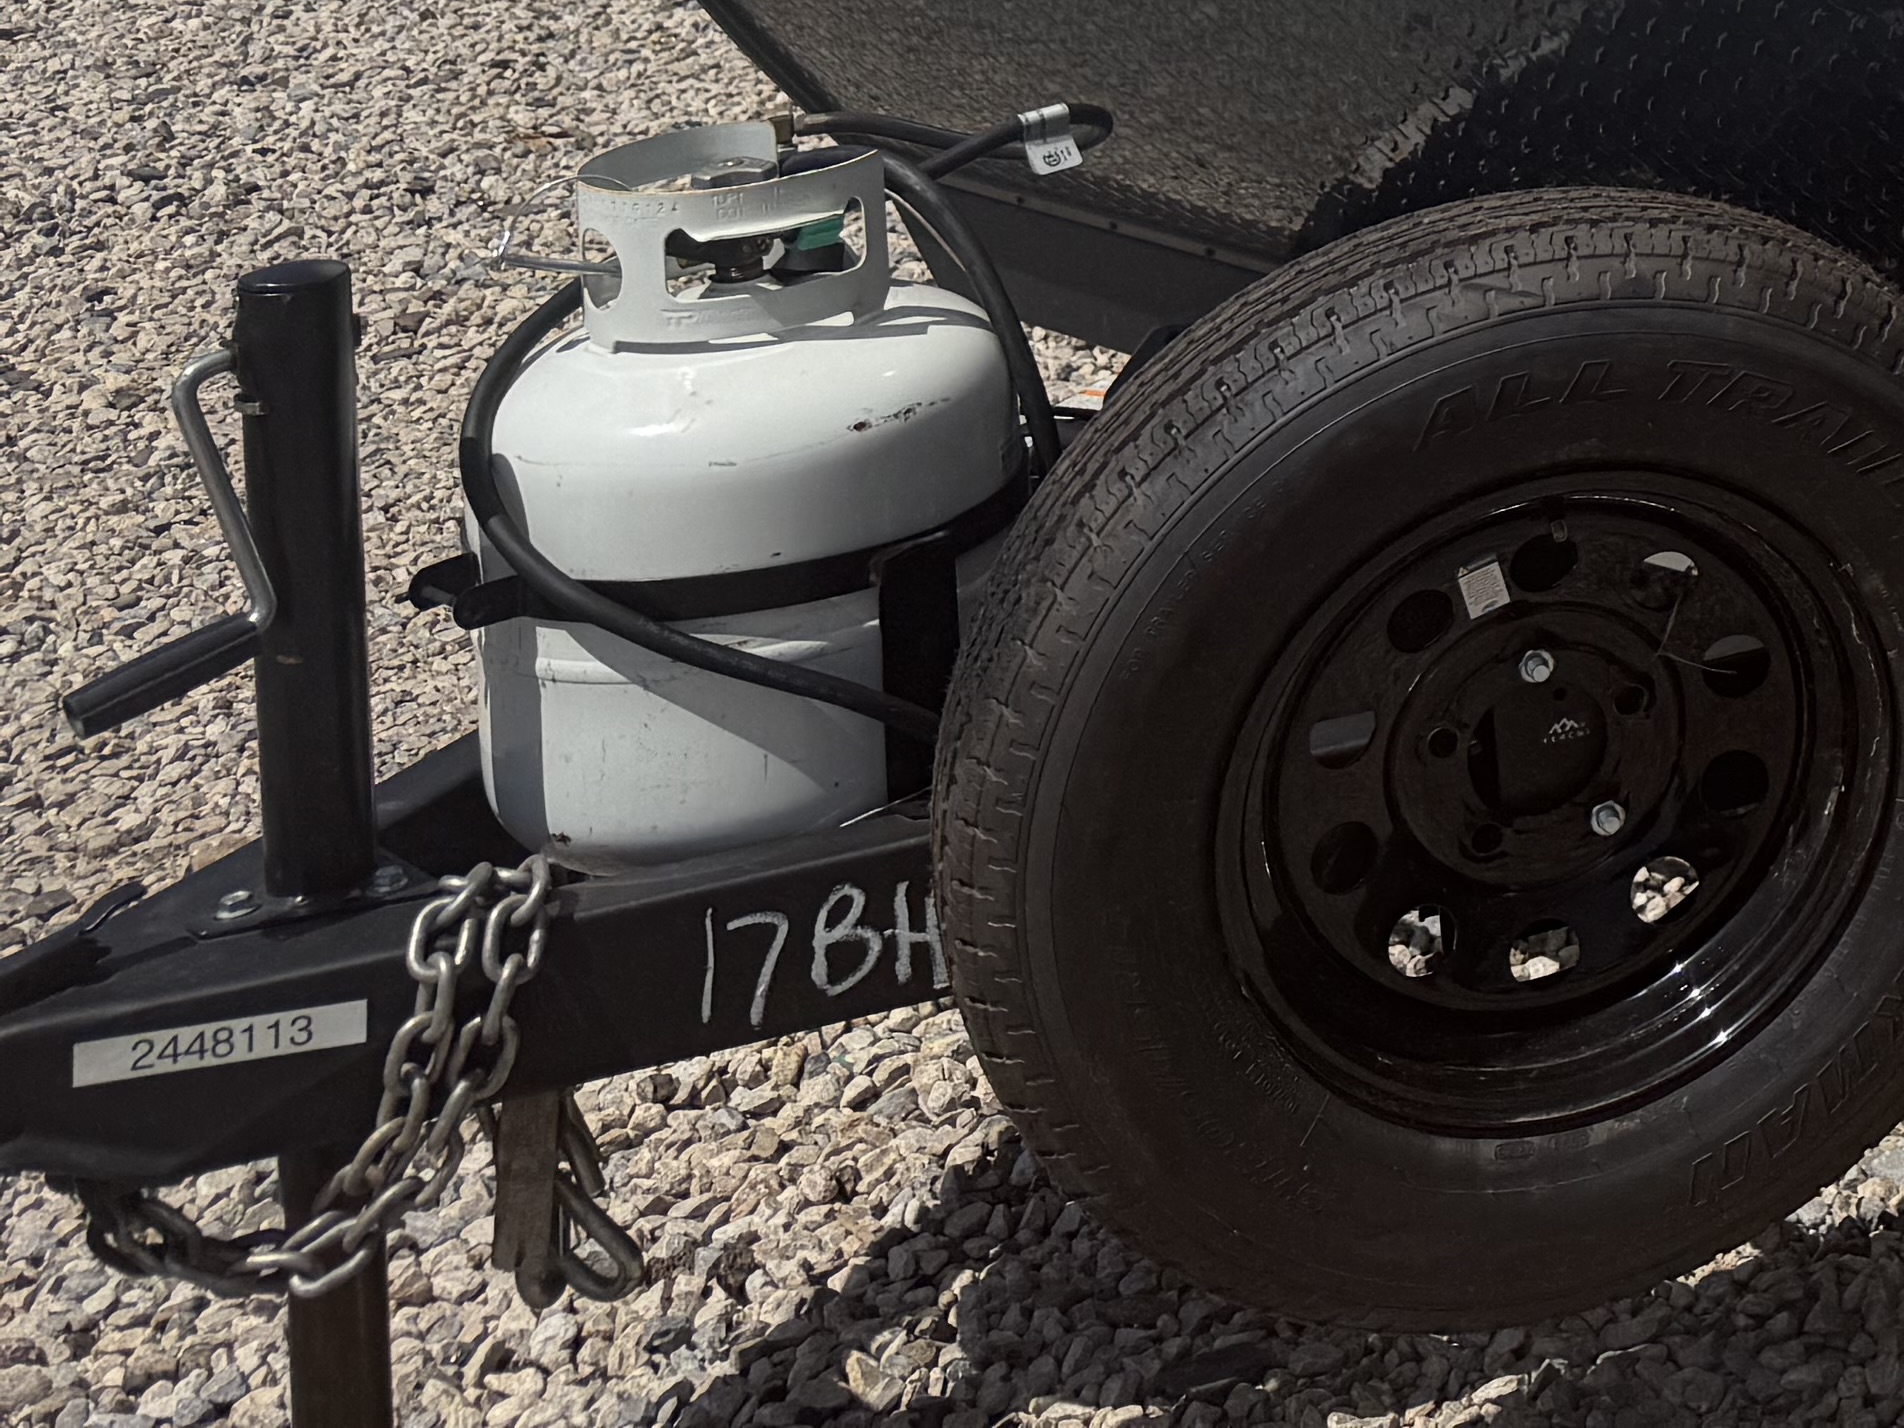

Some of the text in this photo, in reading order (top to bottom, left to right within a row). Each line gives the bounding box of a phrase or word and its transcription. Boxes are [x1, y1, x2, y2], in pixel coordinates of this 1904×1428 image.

[1412, 358, 1631, 452] ALL
[701, 880, 949, 1030] 17BH
[130, 1015, 313, 1071] 2448113
